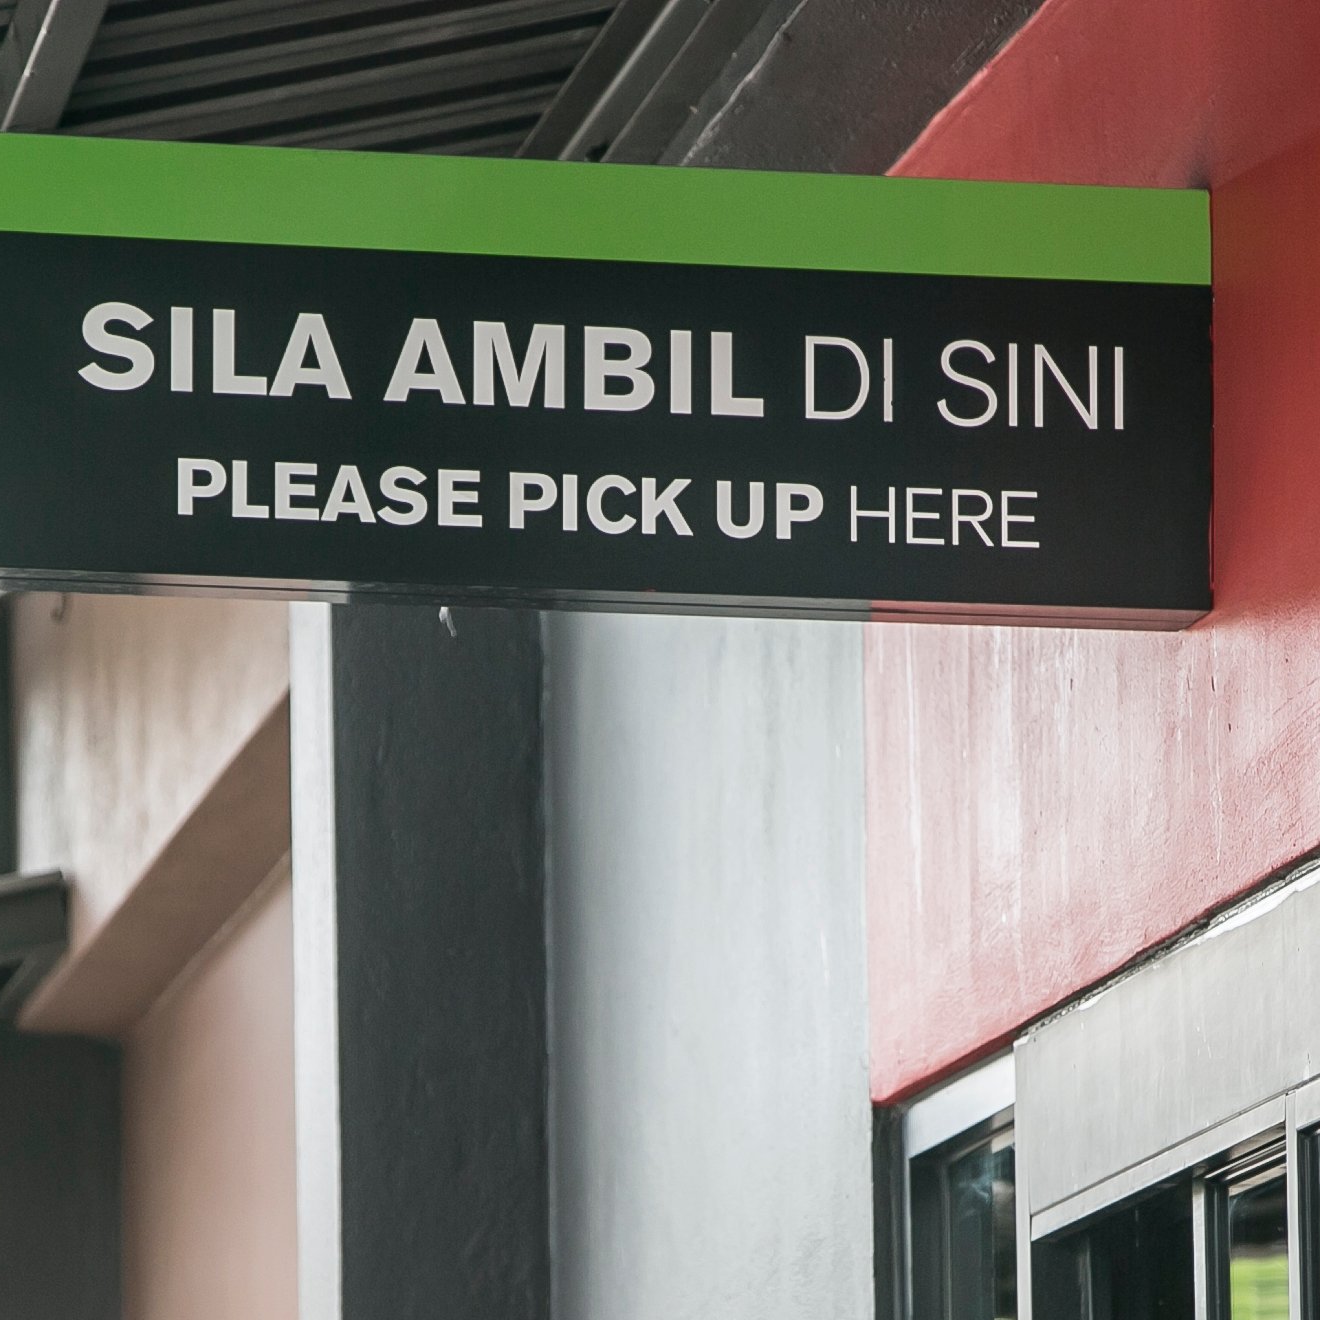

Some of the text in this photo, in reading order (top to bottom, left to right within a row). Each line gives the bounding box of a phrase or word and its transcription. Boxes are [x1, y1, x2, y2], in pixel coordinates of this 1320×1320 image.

[77, 301, 1124, 430] SILA AMBIL DI SINI
[177, 457, 1040, 549] PLEASE PICK UP HERE
